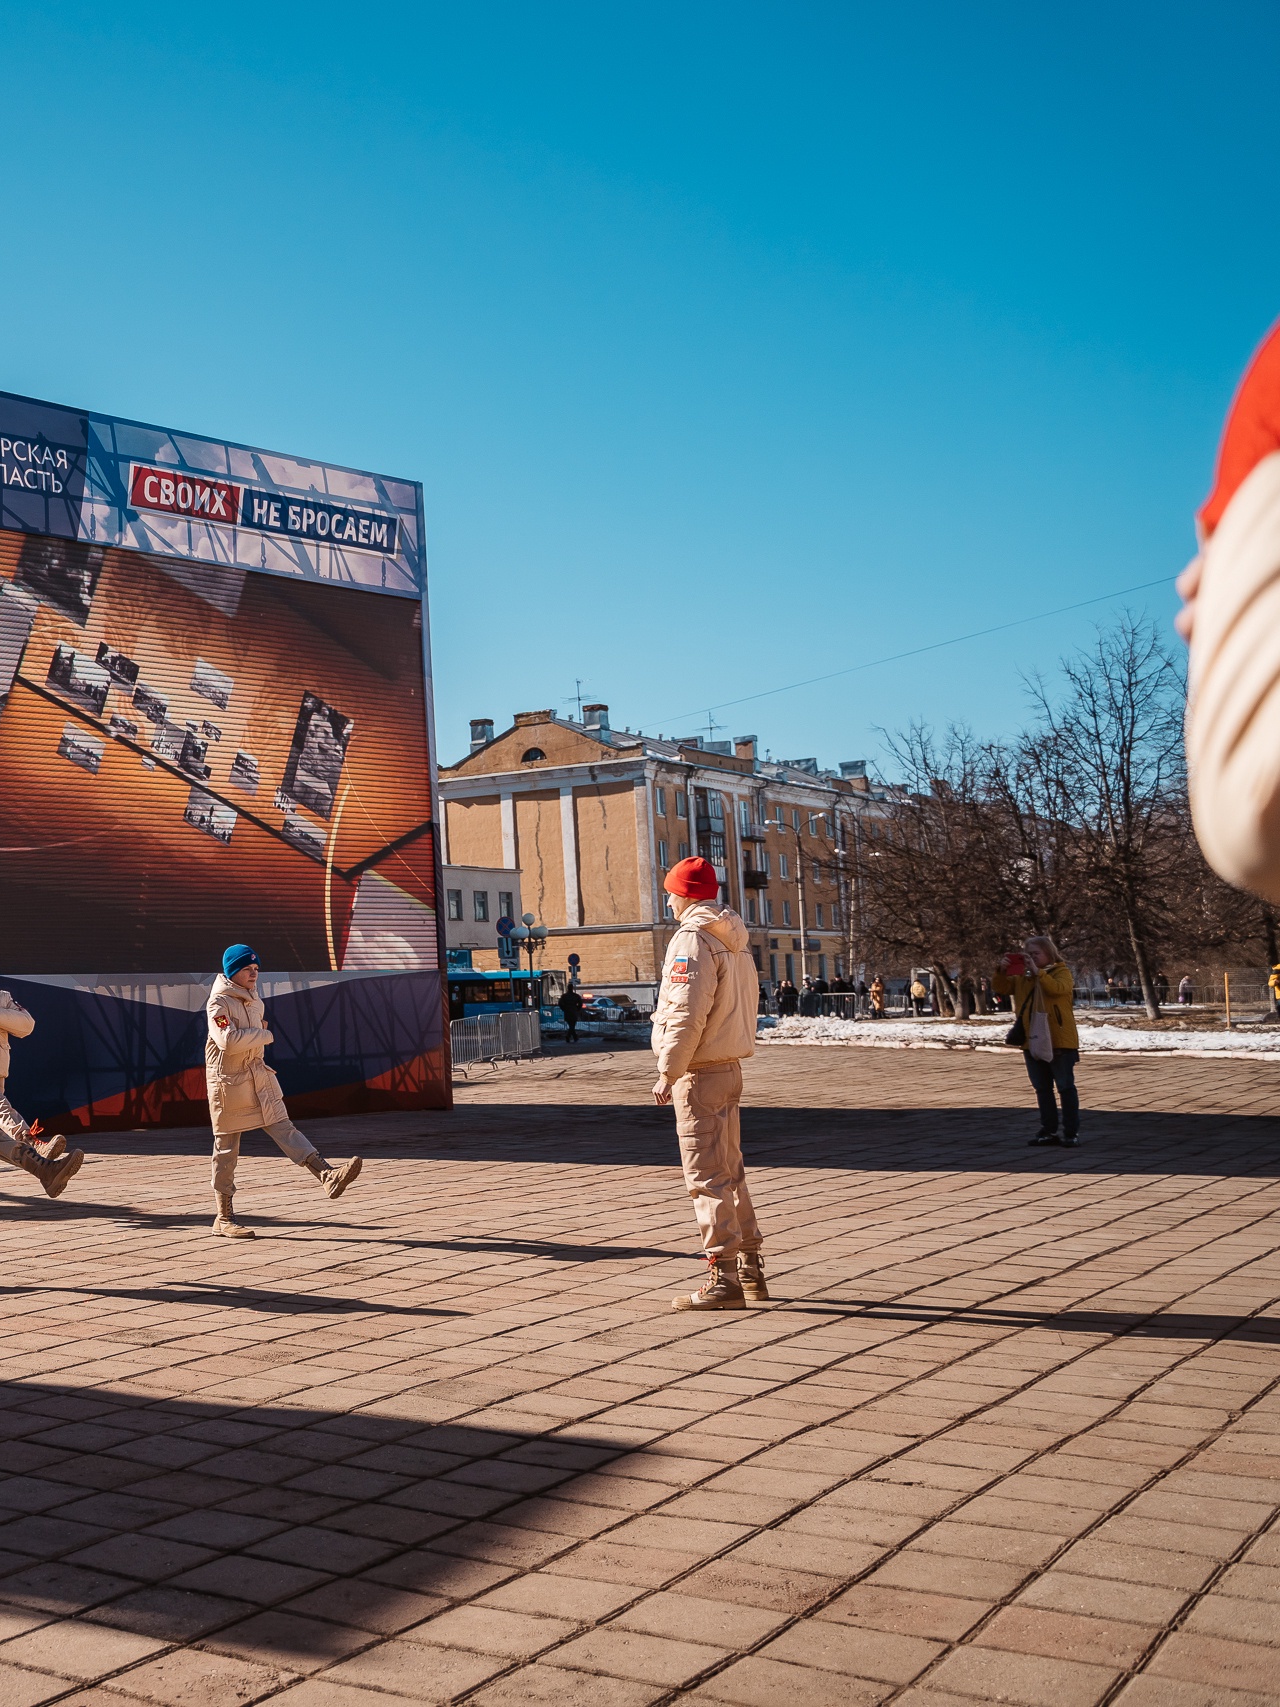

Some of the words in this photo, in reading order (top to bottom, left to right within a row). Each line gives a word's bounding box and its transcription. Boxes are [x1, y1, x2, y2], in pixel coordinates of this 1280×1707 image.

[143, 475, 227, 517] СВОИХ
[253, 498, 281, 528] НЕ
[288, 506, 389, 548] БРОСАЕМ
